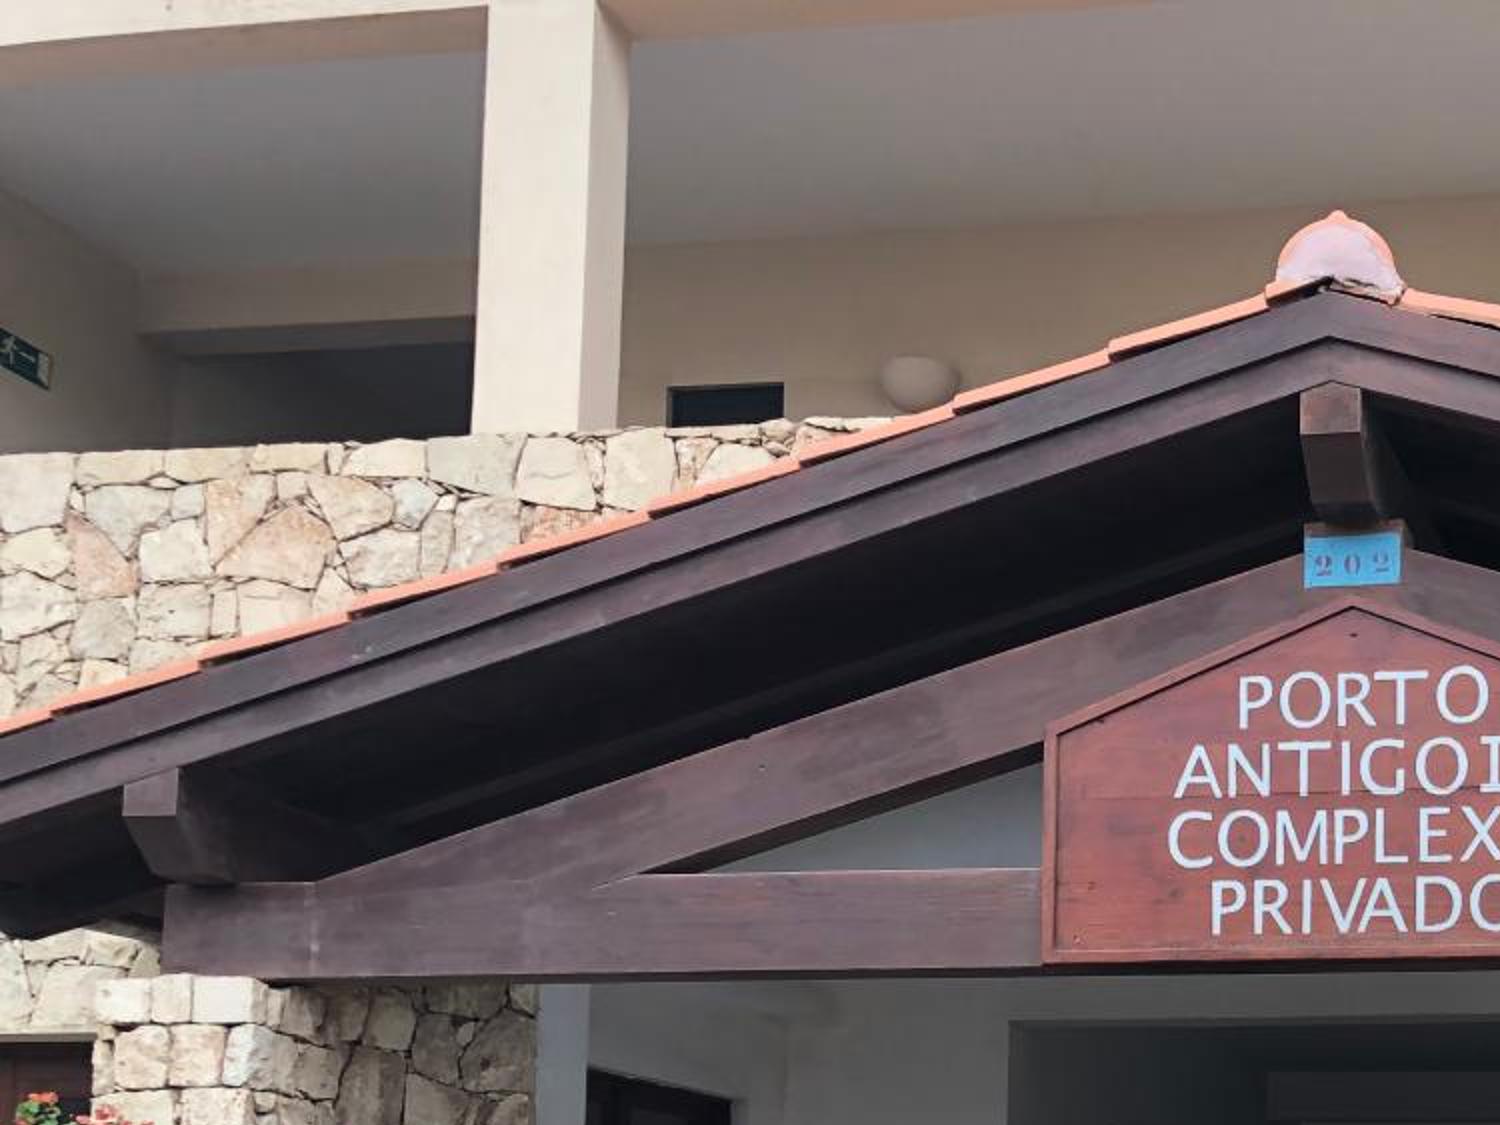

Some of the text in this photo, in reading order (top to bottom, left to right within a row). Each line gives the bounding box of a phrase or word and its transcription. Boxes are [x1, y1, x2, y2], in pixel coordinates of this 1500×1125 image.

[1314, 552, 1391, 577] 202
[1238, 665, 1489, 730] PORTO
[1173, 736, 1469, 798] ANTIGO
